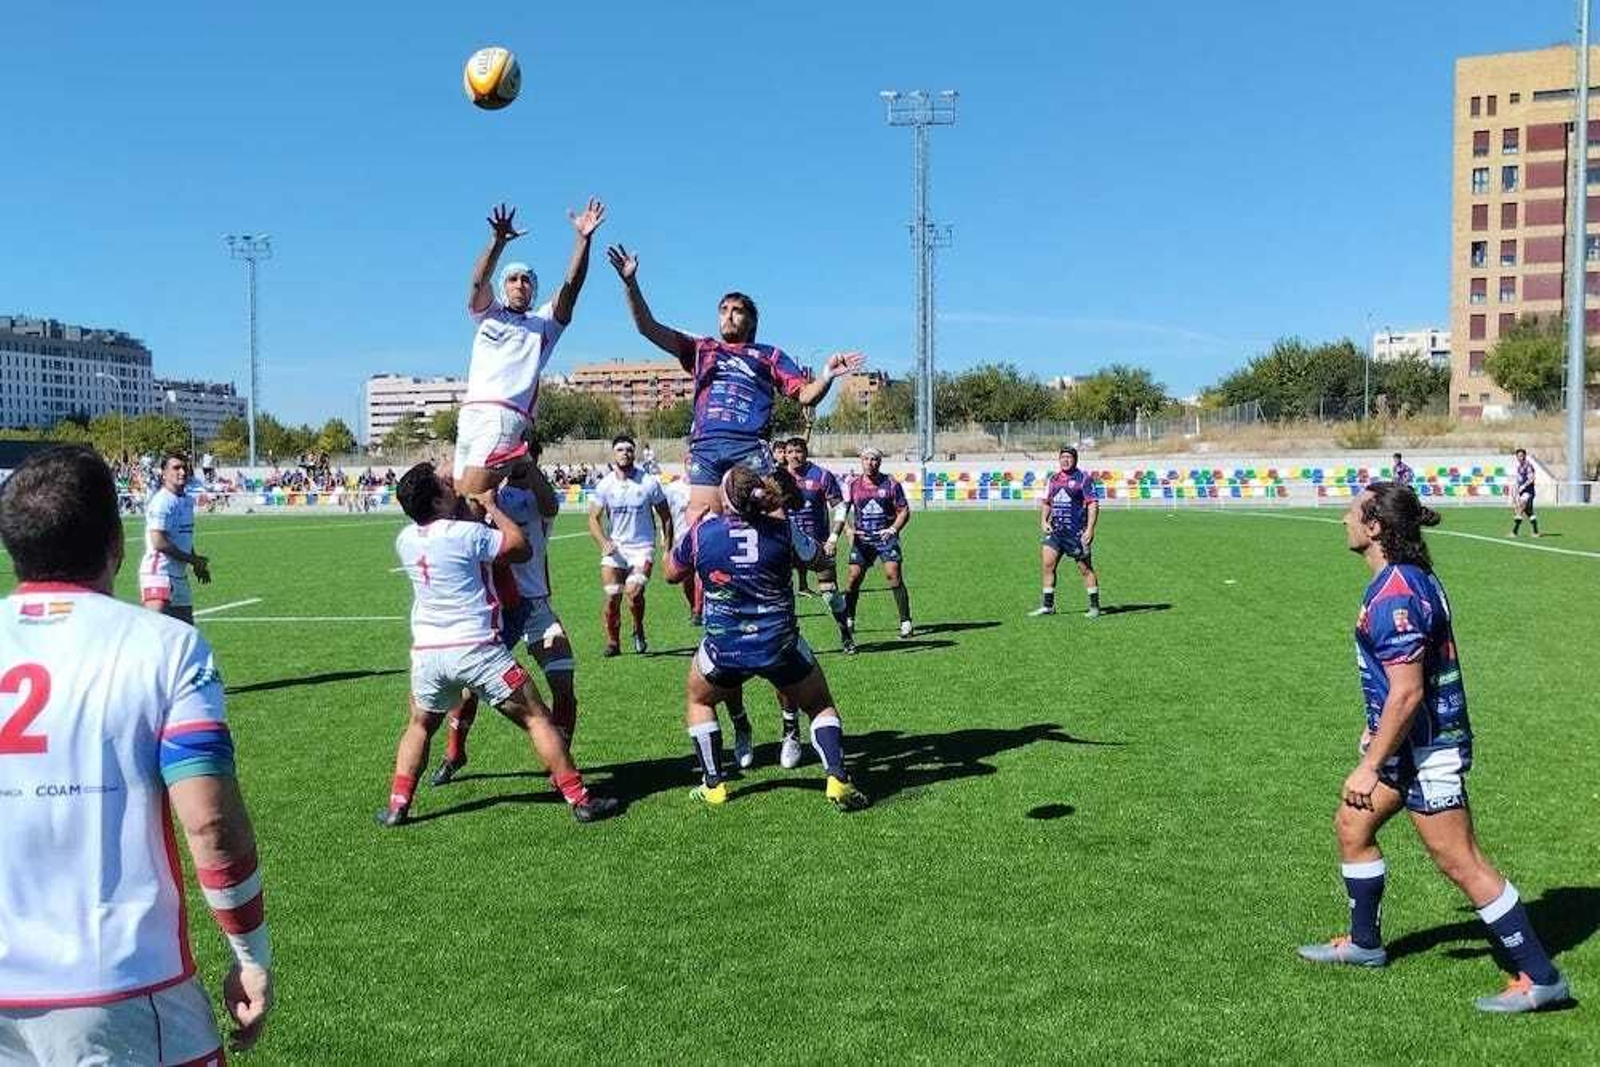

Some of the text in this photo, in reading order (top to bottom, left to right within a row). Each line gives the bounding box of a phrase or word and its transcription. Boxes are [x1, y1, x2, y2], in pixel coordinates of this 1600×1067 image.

[729, 528, 759, 563] 3
[0, 663, 52, 755] 2
[36, 784, 81, 797] COAM
